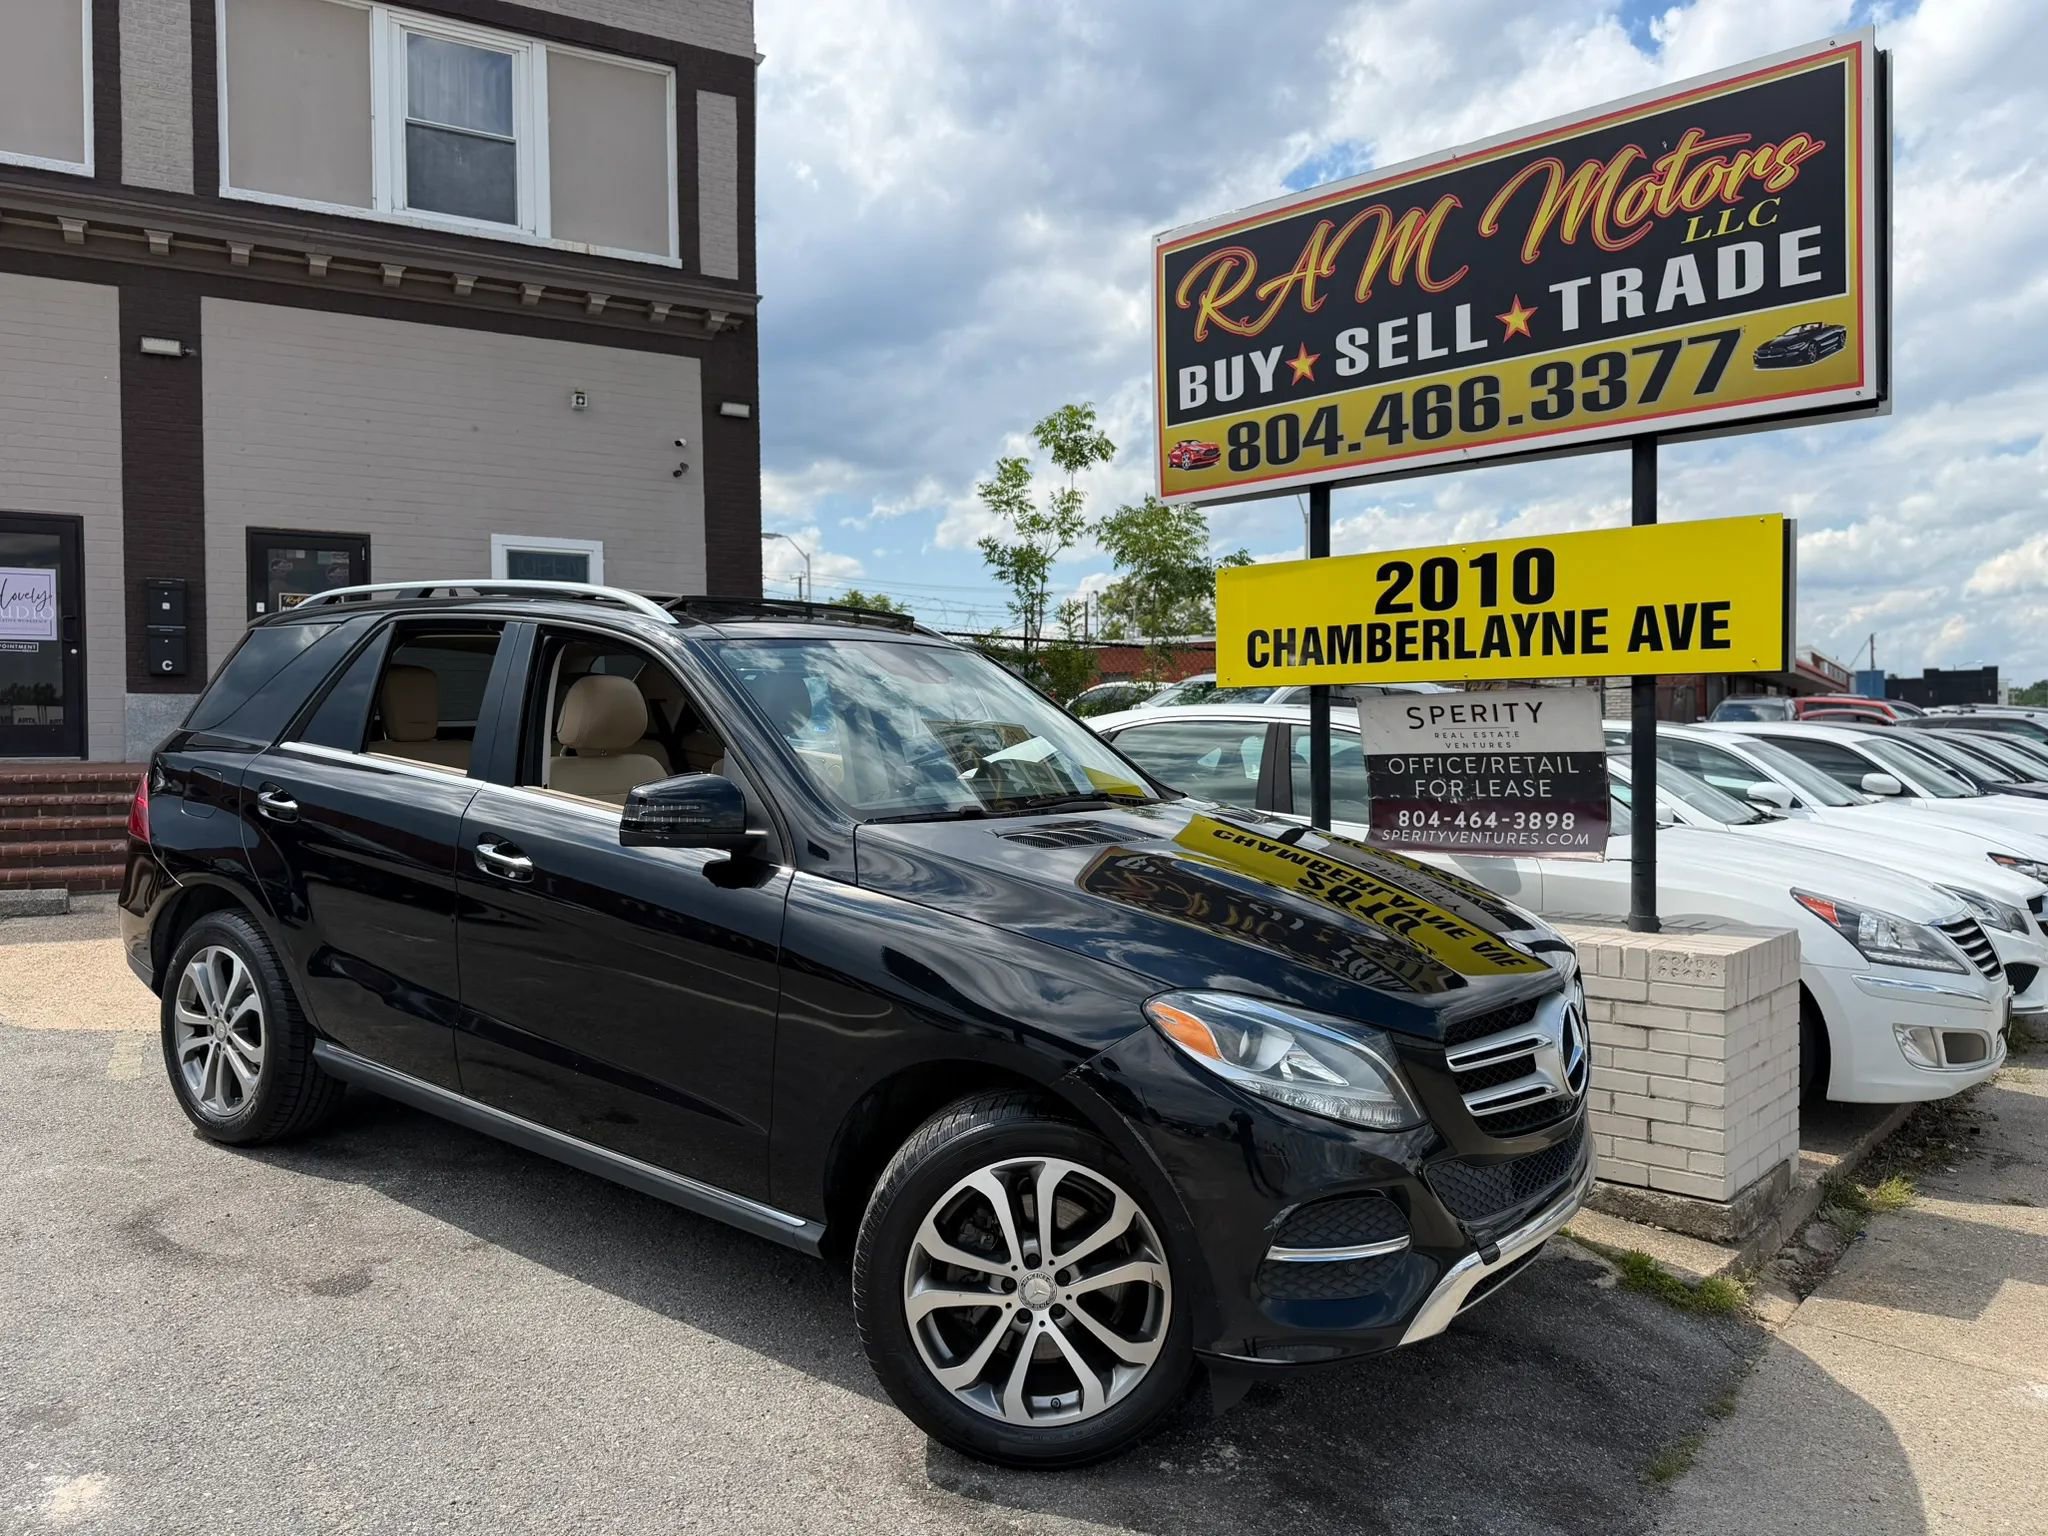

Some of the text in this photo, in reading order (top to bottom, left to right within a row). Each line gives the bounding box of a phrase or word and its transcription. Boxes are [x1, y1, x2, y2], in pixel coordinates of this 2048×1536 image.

[1680, 197, 1783, 245] LLC
[1176, 127, 1826, 343] RAM Motors
[1177, 225, 1823, 411] BUY SELL TRADE
[1226, 327, 1746, 473] 804.466.3377
[1374, 547, 1556, 616] 2010
[1246, 600, 1732, 669] CHAMBERLAYNE AVE
[161, 659, 173, 671] C
[1406, 701, 1543, 730] SPERITY
[1434, 730, 1520, 739] REAL ESTATE
[1445, 741, 1512, 749] VENTURES
[1388, 755, 1580, 775] OFFICE/RETAIL
[1415, 780, 1552, 798] FOR LEASE
[1398, 810, 1575, 830] 804-464-3898
[1382, 829, 1589, 845] SPERITYVENTURES.COM
